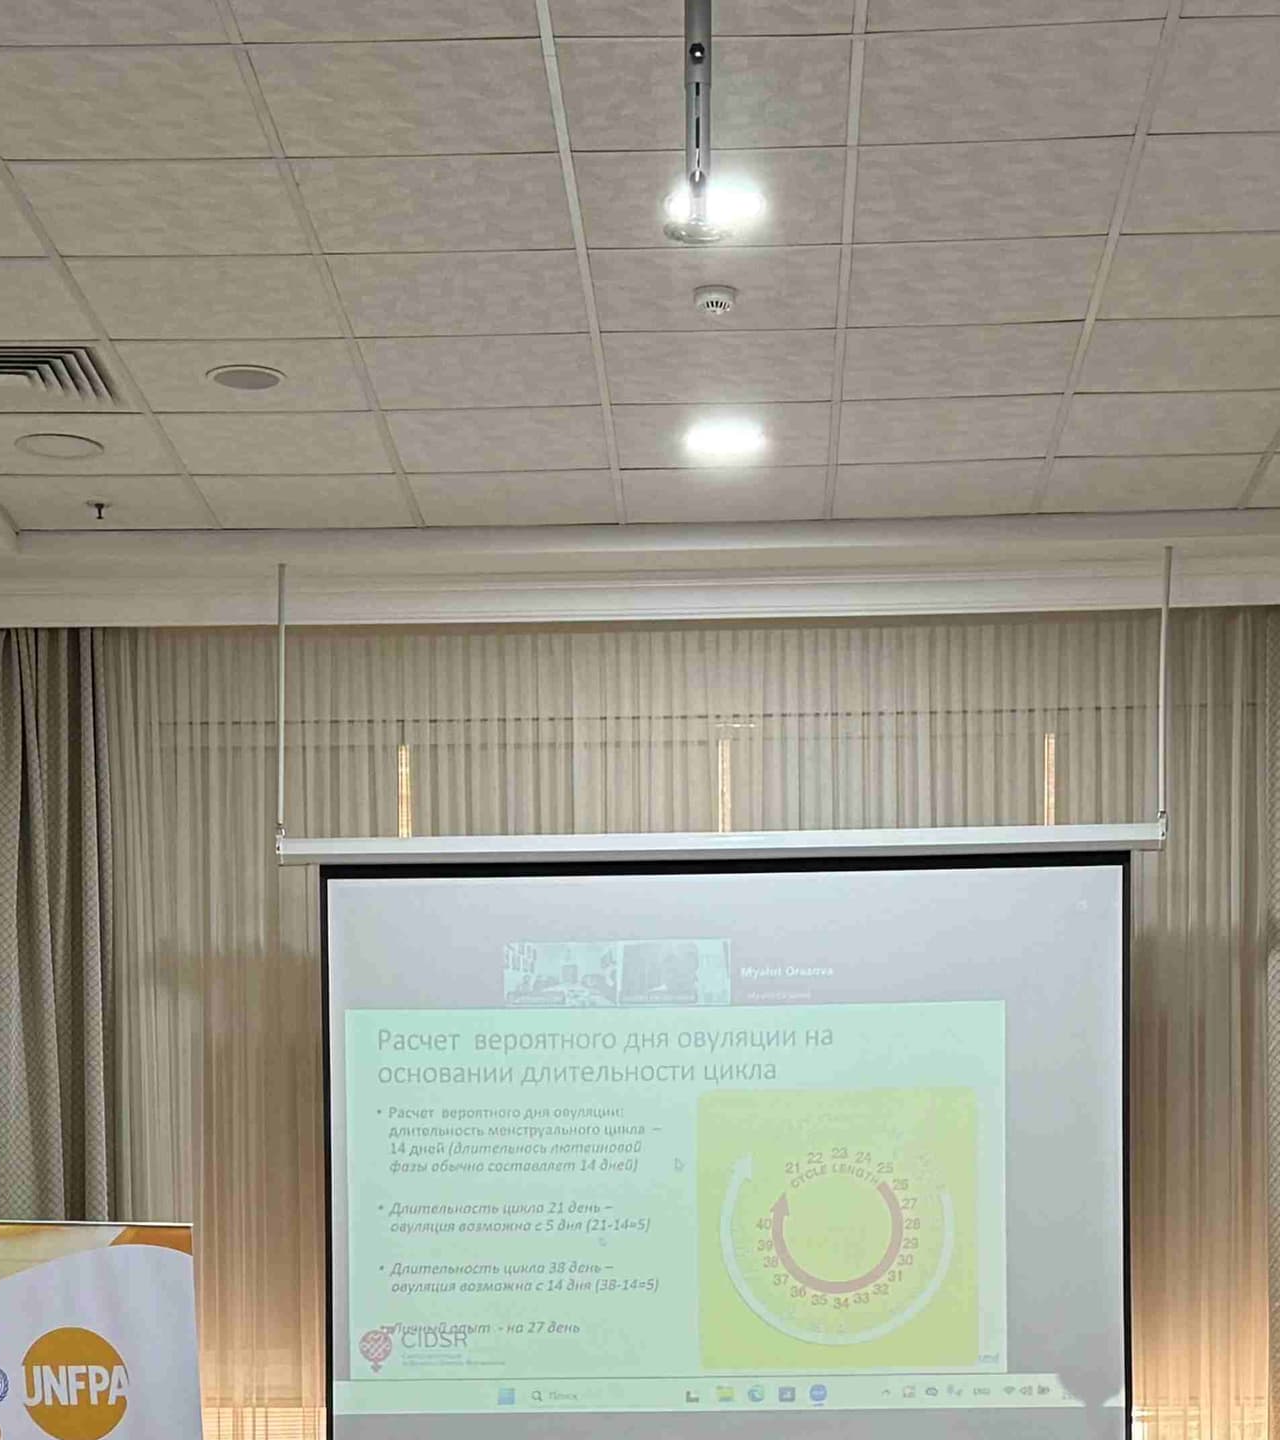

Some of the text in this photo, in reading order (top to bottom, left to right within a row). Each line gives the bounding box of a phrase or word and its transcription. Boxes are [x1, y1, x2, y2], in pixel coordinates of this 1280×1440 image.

[378, 1027, 833, 1055] Расчет вероятного дня овуляции на
[378, 1061, 777, 1085] основании длительности цикла
[388, 1106, 434, 1119] Расчет
[441, 1107, 521, 1120] вероятного
[523, 1107, 550, 1120] дня
[388, 1126, 484, 1138] длительность
[487, 1125, 600, 1139] менструального
[604, 1125, 645, 1137] цикла
[391, 1142, 405, 1154] 14
[409, 1142, 445, 1156] дней
[831, 1147, 848, 1159] 23
[807, 1152, 823, 1164] 22
[855, 1151, 871, 1163] 24
[389, 1159, 428, 1175] фазы
[431, 1159, 484, 1172] обычно
[580, 1159, 596, 1171] 14
[785, 1161, 800, 1174] 21
[876, 1161, 894, 1174] 25
[790, 1164, 880, 1188] CYCLE LENGTH
[389, 1202, 499, 1217] Длительность
[502, 1204, 544, 1217] цикла
[548, 1202, 564, 1213] 21
[568, 1201, 600, 1213] день
[901, 1198, 917, 1210] 27
[390, 1220, 455, 1234] овуляция
[458, 1220, 531, 1232] возможна
[545, 1219, 554, 1231] 5
[557, 1217, 582, 1231] дня
[756, 1218, 772, 1231] 40
[757, 1240, 773, 1252] 39
[903, 1237, 919, 1250] 29
[763, 1256, 778, 1268] 38
[897, 1254, 913, 1266] 30
[390, 1262, 500, 1277] Длительность
[504, 1264, 545, 1277] цикла
[548, 1262, 566, 1274] 38
[568, 1260, 601, 1273] день
[773, 1274, 789, 1286] 37
[888, 1270, 903, 1282] 31
[391, 1280, 456, 1294] овуляция
[460, 1280, 532, 1293] возможна
[548, 1279, 563, 1291] 14
[566, 1278, 592, 1292] дня
[790, 1286, 807, 1298] 36
[872, 1283, 889, 1296] 32
[811, 1294, 828, 1307] 35
[833, 1297, 849, 1309] 34
[853, 1292, 870, 1305] 33
[507, 1324, 524, 1333] на
[528, 1322, 545, 1333] 27
[547, 1321, 581, 1333] день
[401, 1332, 468, 1349] CIDSR
[22, 1365, 130, 1406] UNFPA
